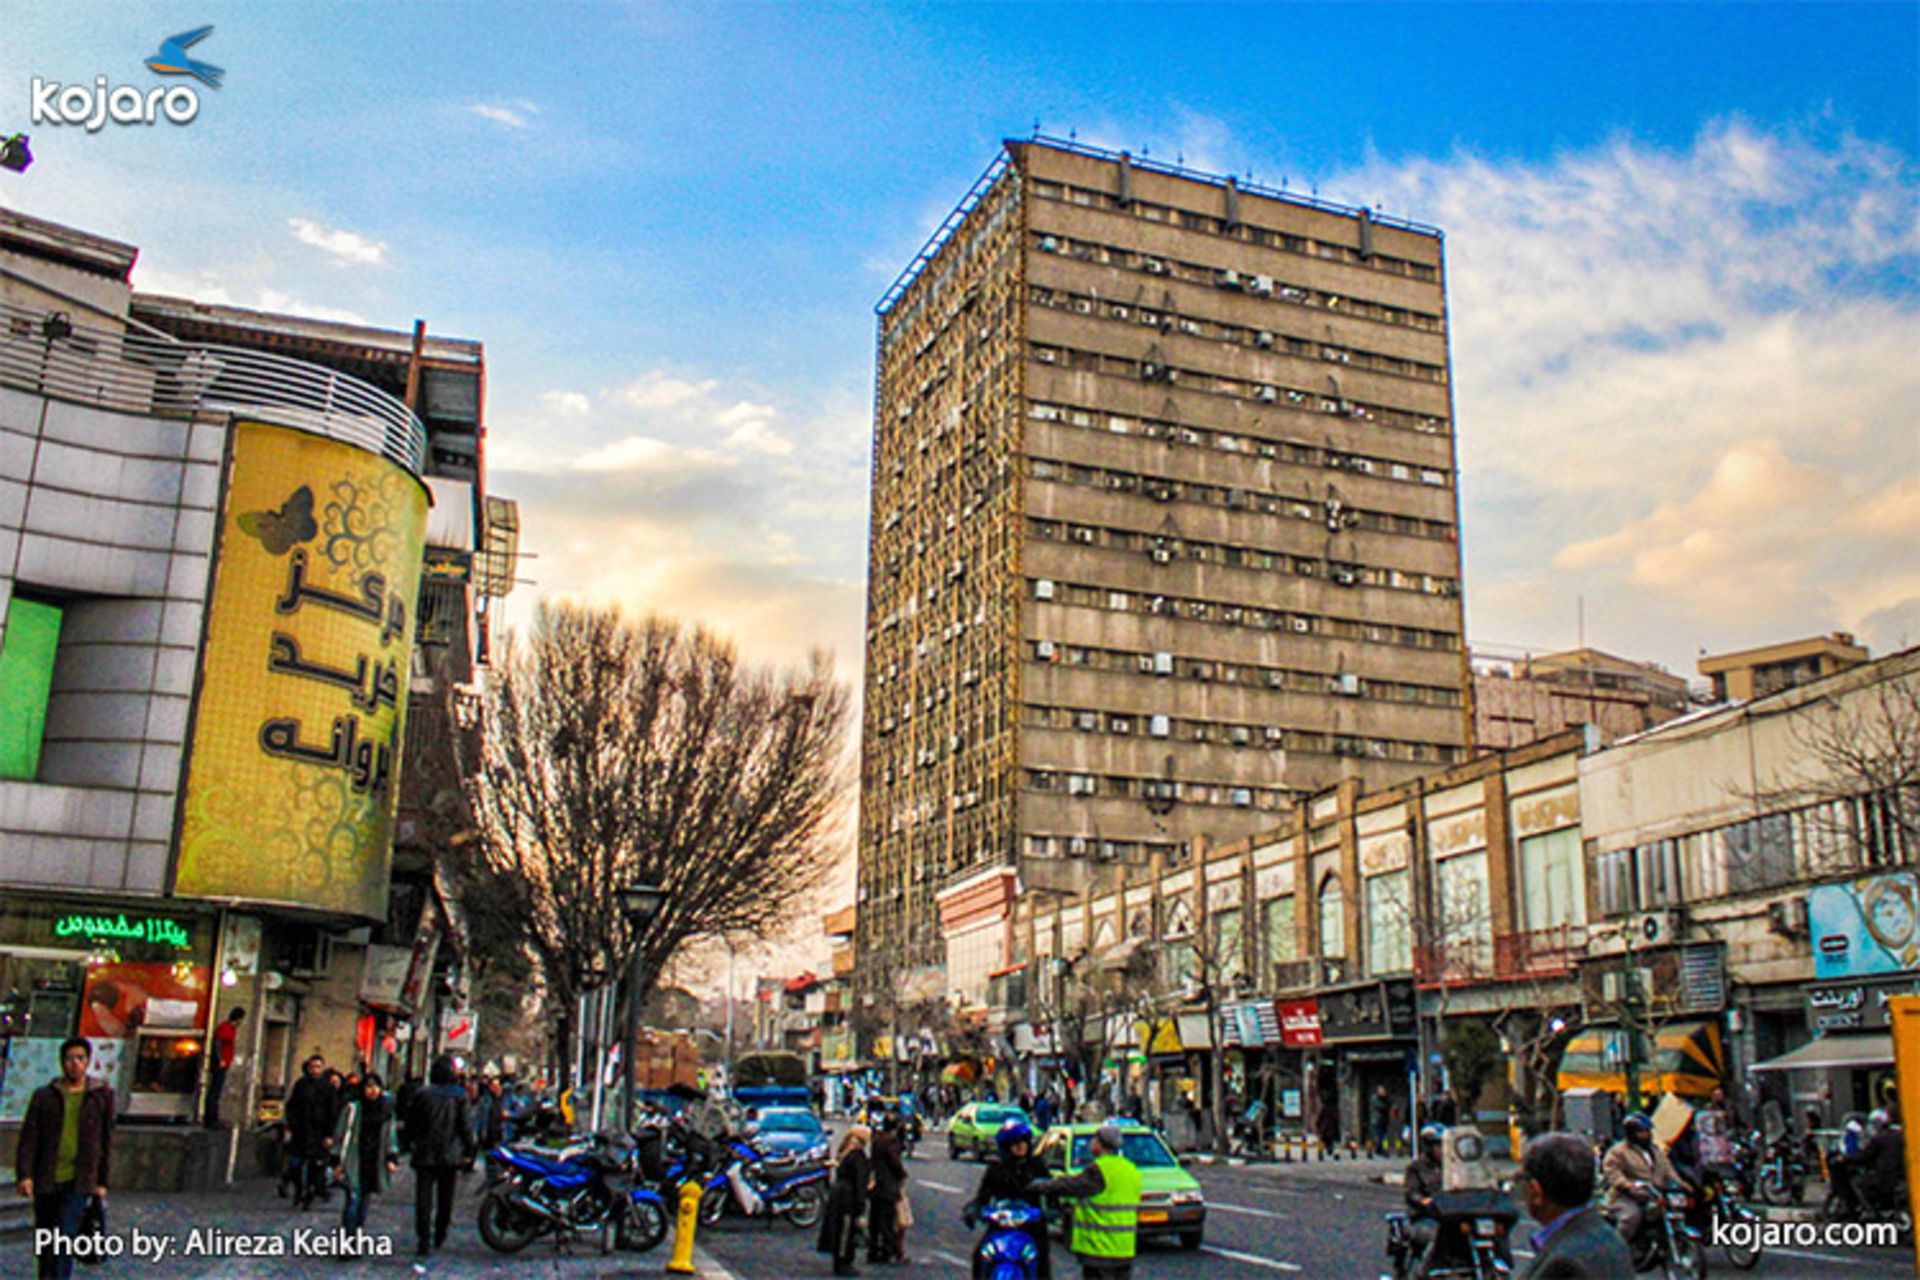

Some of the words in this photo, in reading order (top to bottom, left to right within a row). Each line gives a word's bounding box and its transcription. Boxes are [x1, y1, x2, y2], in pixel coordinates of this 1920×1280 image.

[274, 548, 405, 648] مرکز
[266, 629, 398, 714] خرید
[257, 716, 391, 796] پروانه
